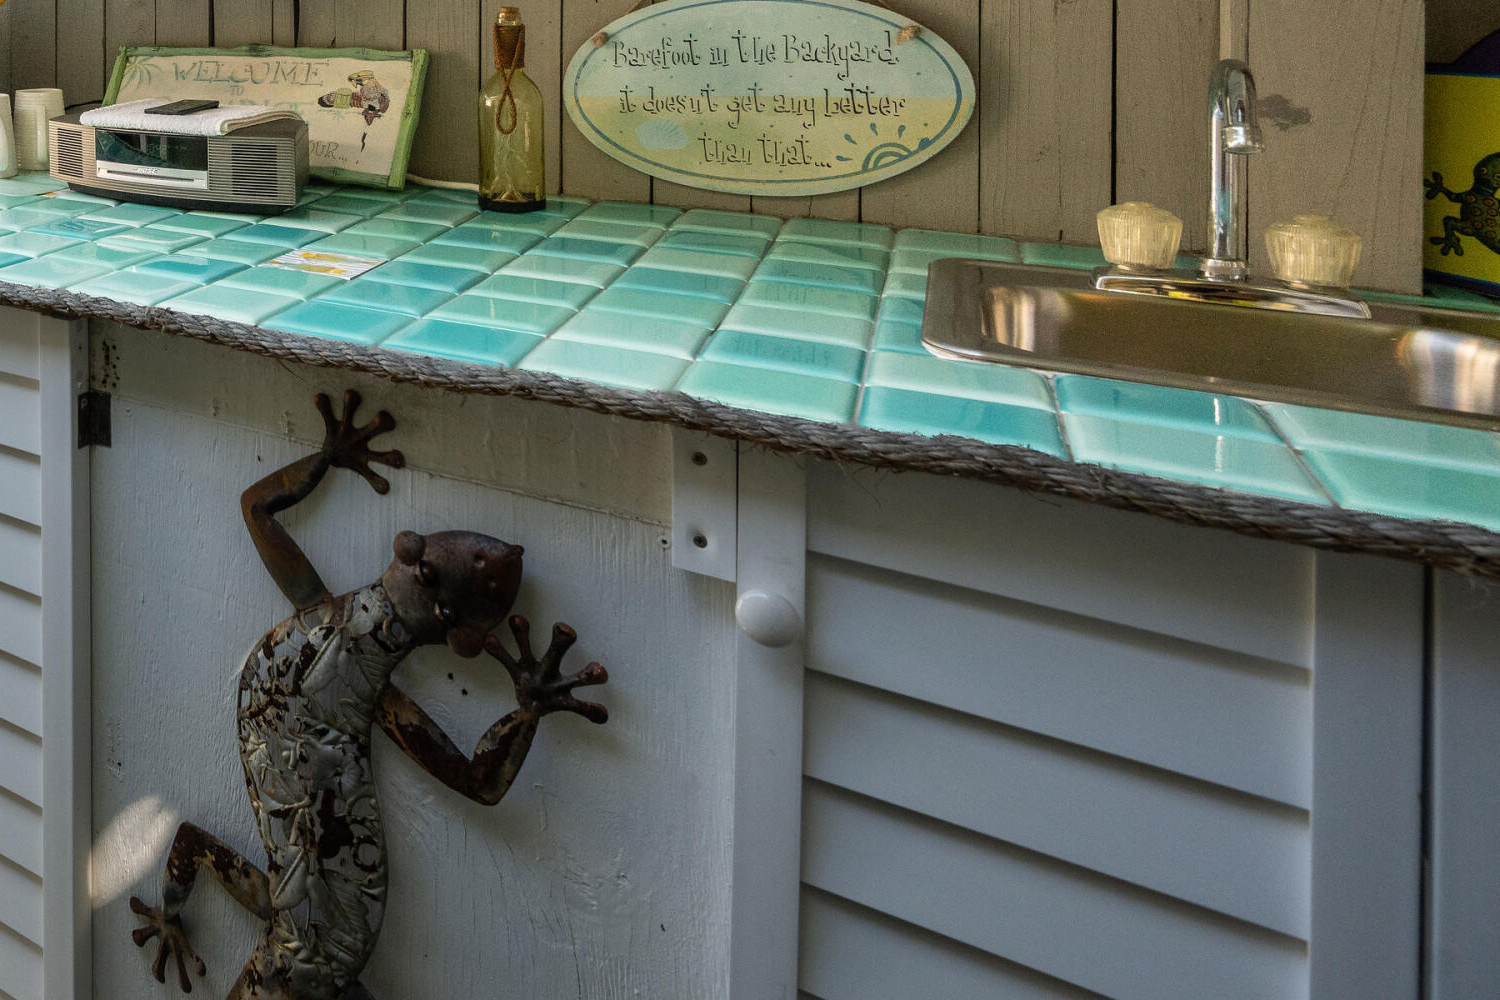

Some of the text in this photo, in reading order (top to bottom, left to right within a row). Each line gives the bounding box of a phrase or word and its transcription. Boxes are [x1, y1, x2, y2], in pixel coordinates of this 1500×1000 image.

[612, 33, 701, 69] Barefoot
[708, 43, 727, 66] in
[736, 29, 776, 66] the
[172, 60, 331, 87] WELCOME
[229, 84, 245, 96] TO
[619, 82, 906, 129] it doesn't get any better
[698, 131, 832, 168] than that...
